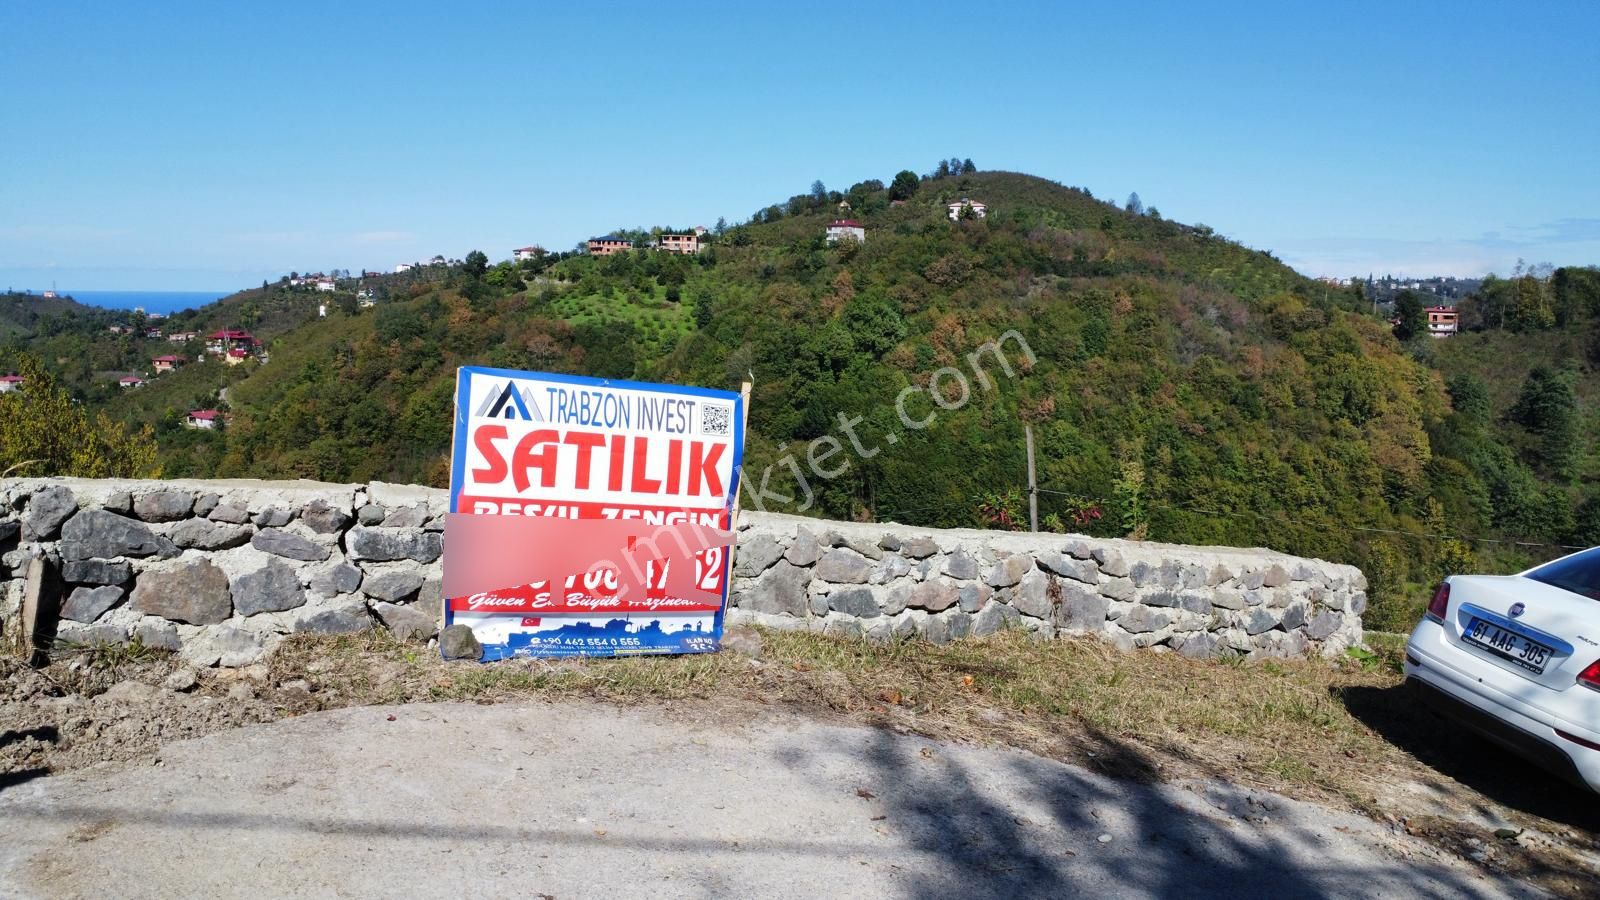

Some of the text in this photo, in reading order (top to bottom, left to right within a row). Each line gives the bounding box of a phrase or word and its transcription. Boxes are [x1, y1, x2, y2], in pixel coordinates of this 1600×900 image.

[546, 387, 695, 434] TRABZON INVEST
[471, 424, 727, 498] SATILIK
[467, 592, 526, 610] Güven
[532, 592, 556, 607] E
[566, 592, 621, 611] Büyük
[564, 638, 585, 646] 462
[587, 638, 609, 646] 554
[610, 638, 618, 646] 0
[620, 637, 641, 646] 555
[1473, 622, 1489, 640] 61
[1489, 630, 1517, 652] AAG
[1519, 642, 1548, 665] 305
